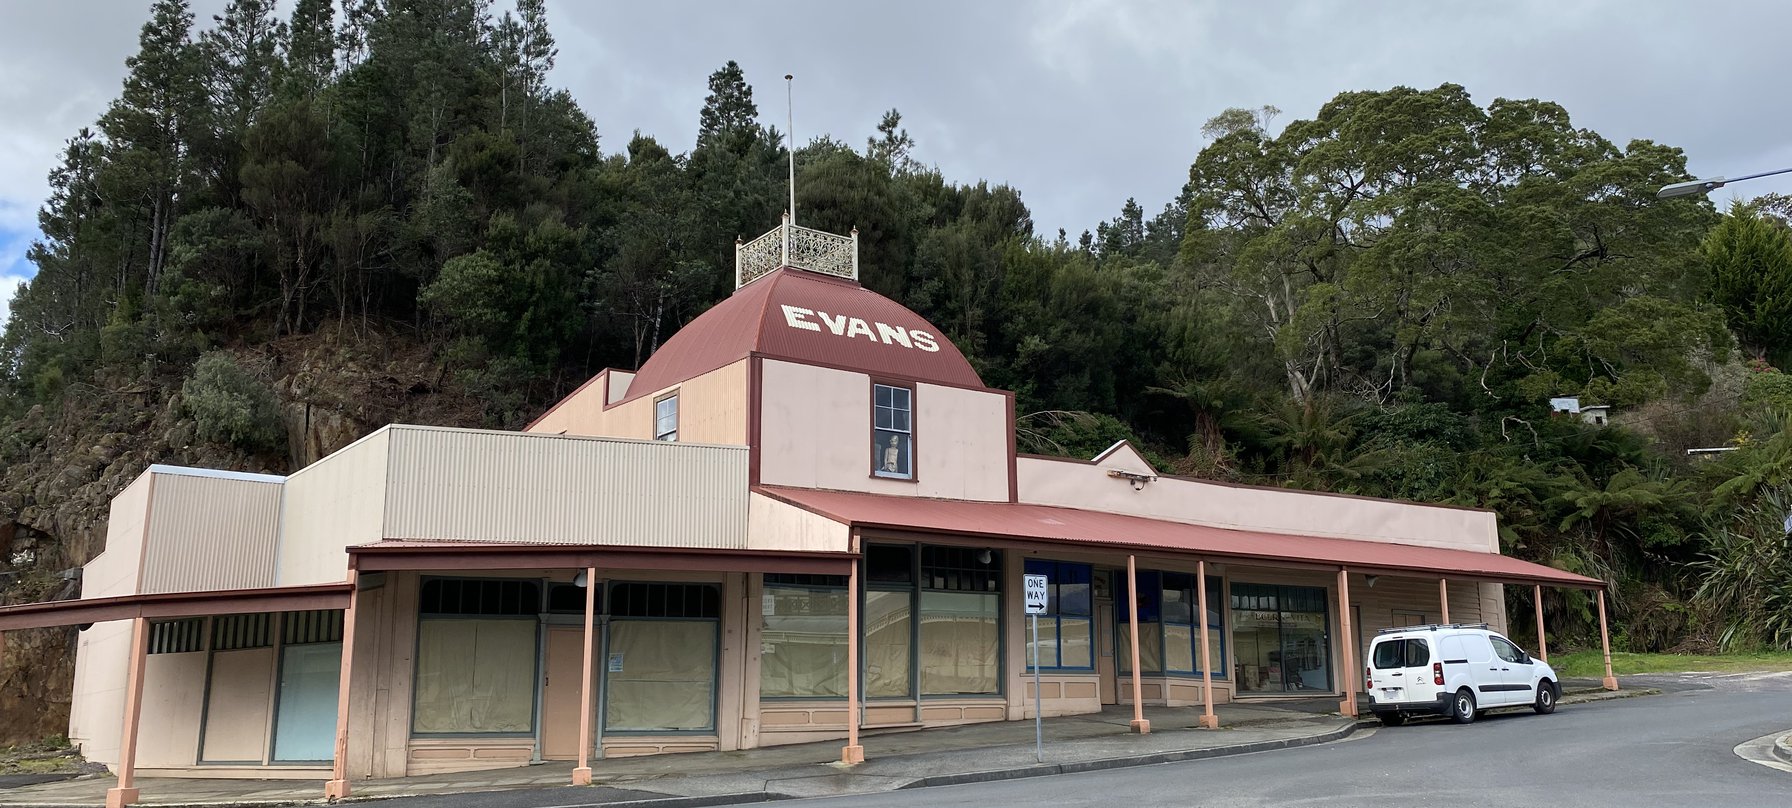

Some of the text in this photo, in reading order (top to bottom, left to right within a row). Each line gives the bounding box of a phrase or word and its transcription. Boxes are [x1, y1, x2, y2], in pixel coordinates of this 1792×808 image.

[781, 304, 940, 352] EVANS
[1028, 578, 1044, 588] ONE
[1027, 590, 1045, 600] WAY
